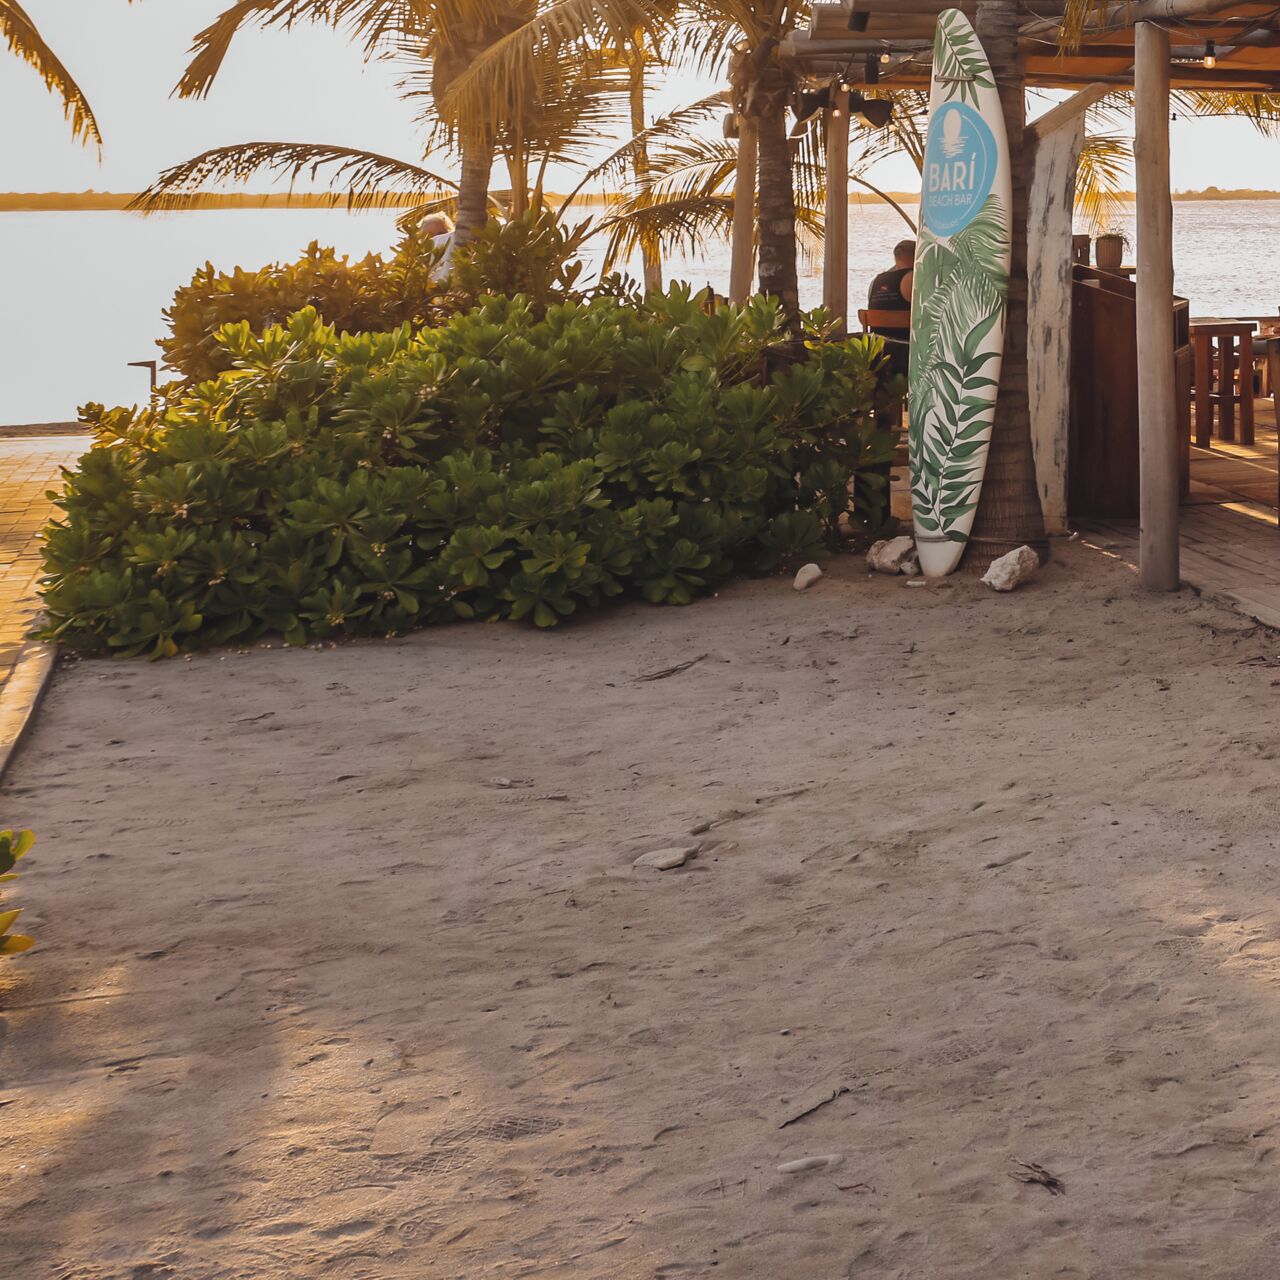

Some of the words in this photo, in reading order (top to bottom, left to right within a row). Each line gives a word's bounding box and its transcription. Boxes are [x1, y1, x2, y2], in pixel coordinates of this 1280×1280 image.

[929, 152, 976, 192] BARÍ
[928, 194, 953, 207] BEACH
[954, 193, 973, 206] BAR
